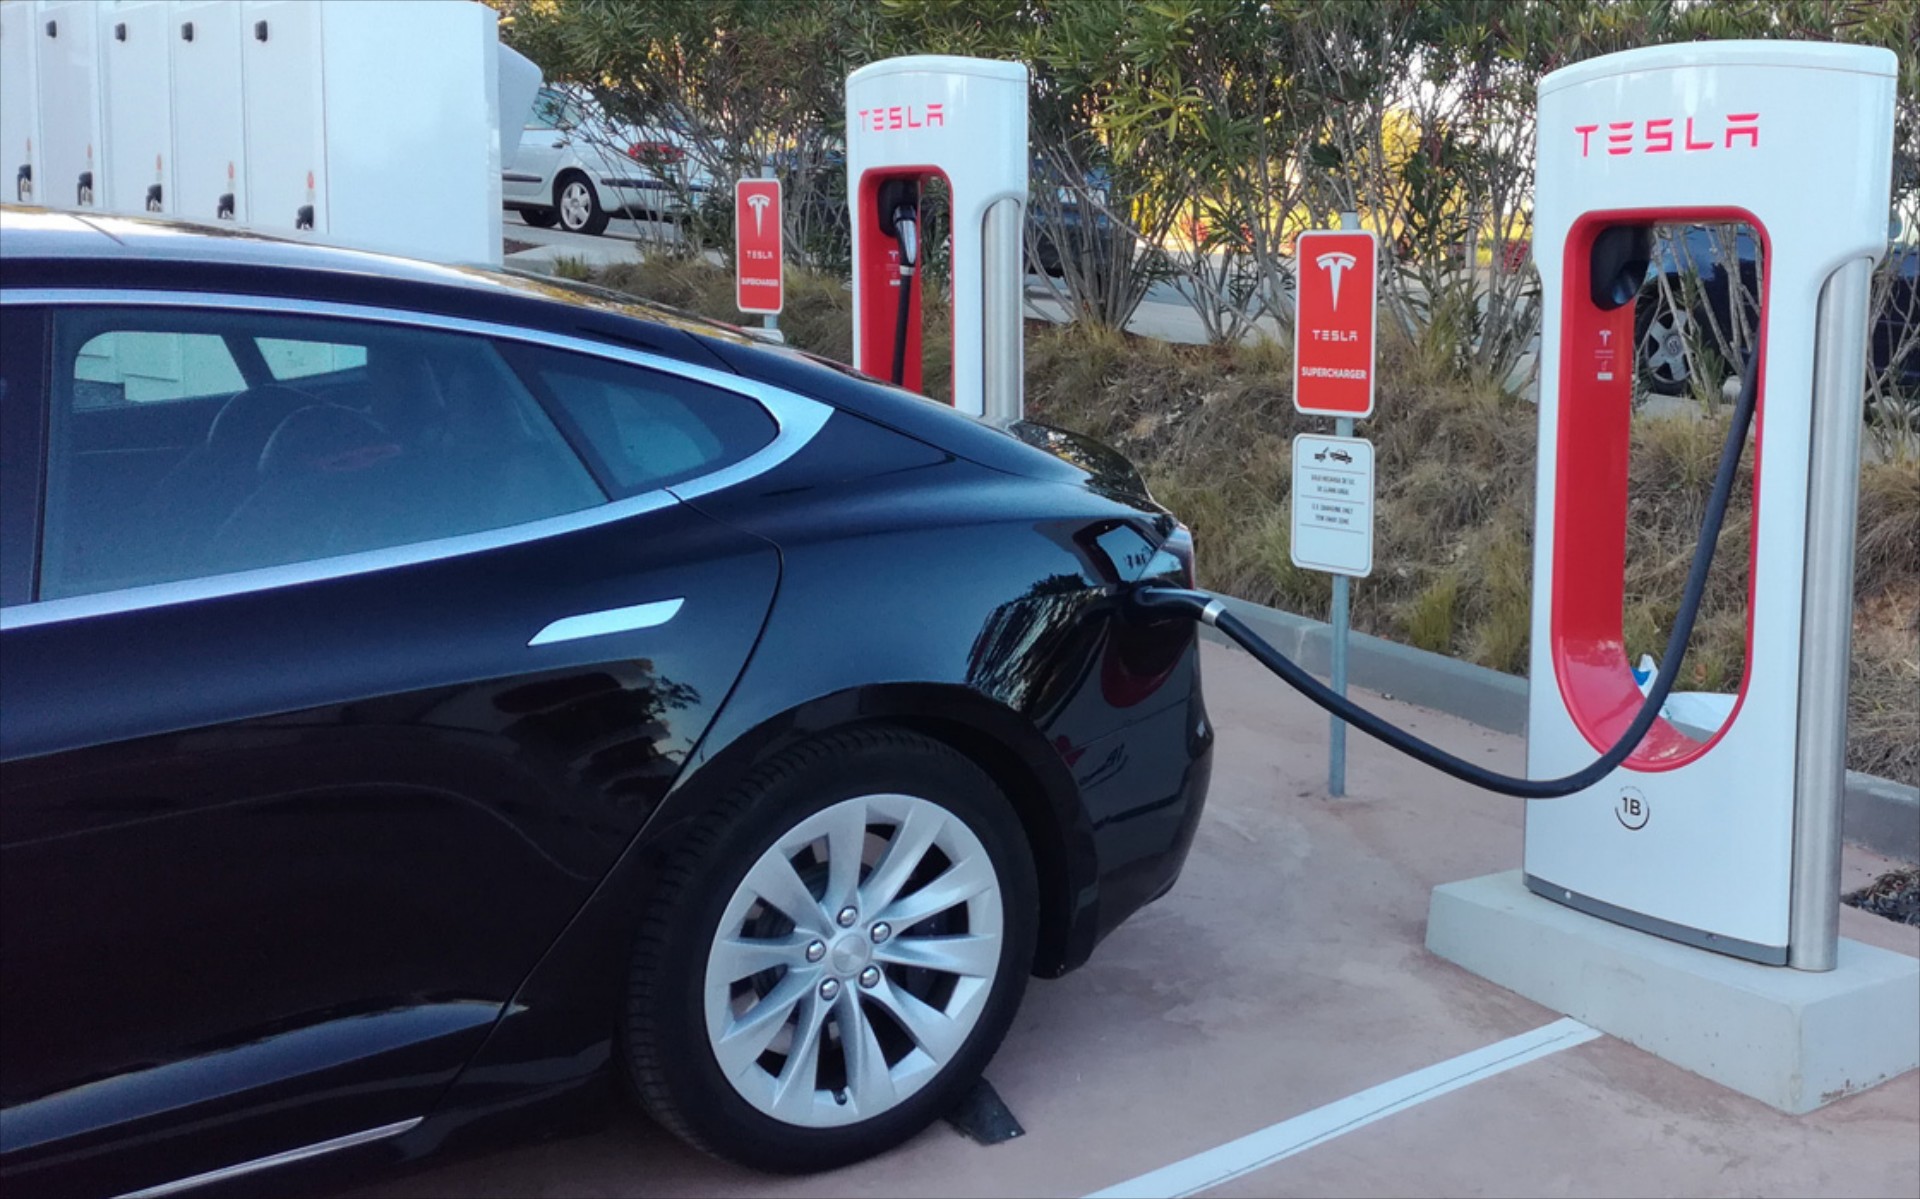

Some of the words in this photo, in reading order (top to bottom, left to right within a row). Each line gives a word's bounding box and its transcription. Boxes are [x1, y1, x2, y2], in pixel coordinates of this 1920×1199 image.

[858, 104, 943, 132] TESLA
[1574, 113, 1759, 157] TESLA
[746, 250, 773, 260] TESLA
[1312, 329, 1358, 342] TESLA
[1301, 366, 1367, 380] SUPERCHARGER
[1622, 796, 1641, 816] 1B
